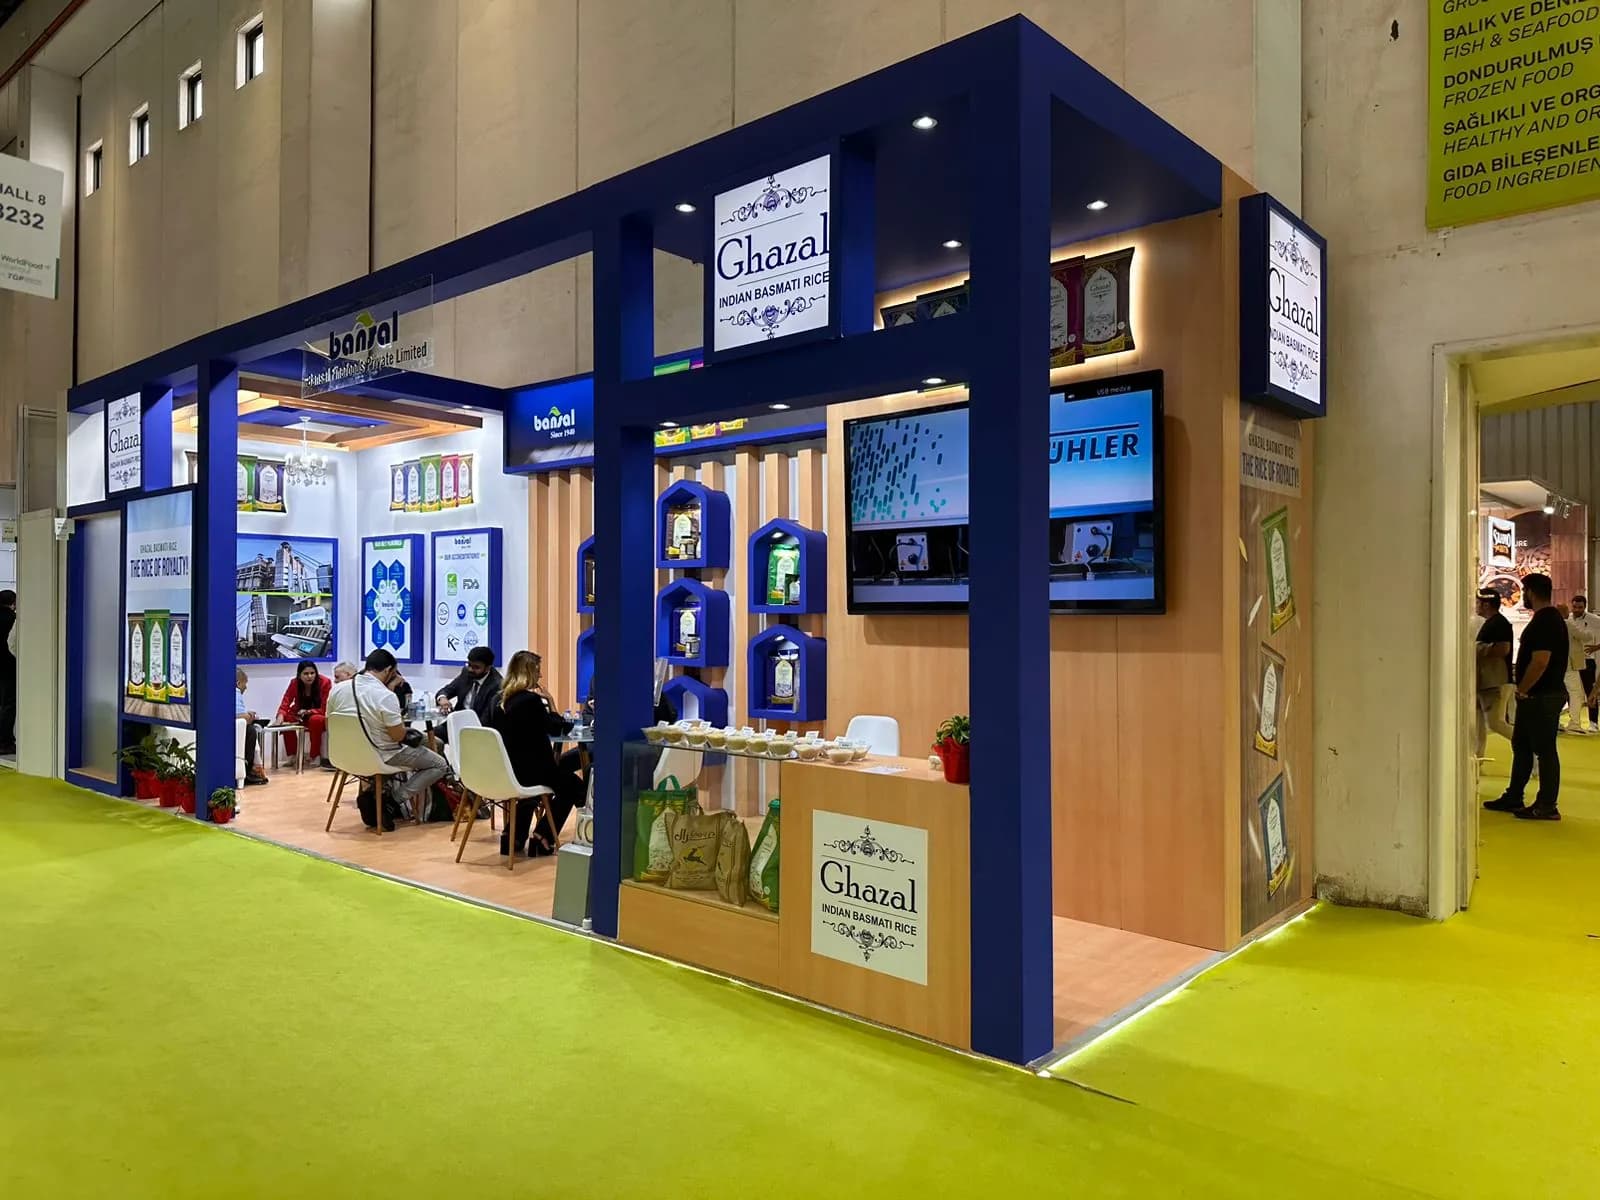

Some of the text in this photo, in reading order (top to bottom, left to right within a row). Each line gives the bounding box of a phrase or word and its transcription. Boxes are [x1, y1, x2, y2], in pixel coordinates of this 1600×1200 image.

[1443, 6, 1600, 61] FISH & SEAFOOD
[1444, 14, 1497, 41] BALIK
[1501, 6, 1525, 24] VE
[1444, 37, 1593, 88] DONDURULMUŞ
[1443, 62, 1574, 109] FROZEN FOOD
[1443, 84, 1600, 136] SAĞLIKLI VE ORG
[1443, 124, 1525, 155] HEALTHY
[1527, 114, 1569, 136] AND
[1443, 136, 1600, 183] GIDA BİLEŞENLE
[1443, 157, 1600, 202] FOOD INGREDIEN
[38, 194, 47, 206] 8
[716, 212, 830, 280] Ghazal
[719, 270, 830, 309] INDIAN BASMATI RICE
[1269, 267, 1319, 338] Ghazal
[329, 310, 398, 360] bansal
[396, 341, 427, 363] Limited
[534, 408, 575, 432] bansal
[110, 428, 140, 454] Ghaza
[1242, 452, 1254, 477] THE
[1254, 455, 1267, 481] RICE
[1268, 460, 1276, 483] OF
[130, 555, 189, 577] THE RICE OF ROYALTY!
[463, 578, 480, 590] FDA
[820, 860, 918, 914] Ghazal
[822, 903, 917, 936] INDIAN BASMATI RICE
